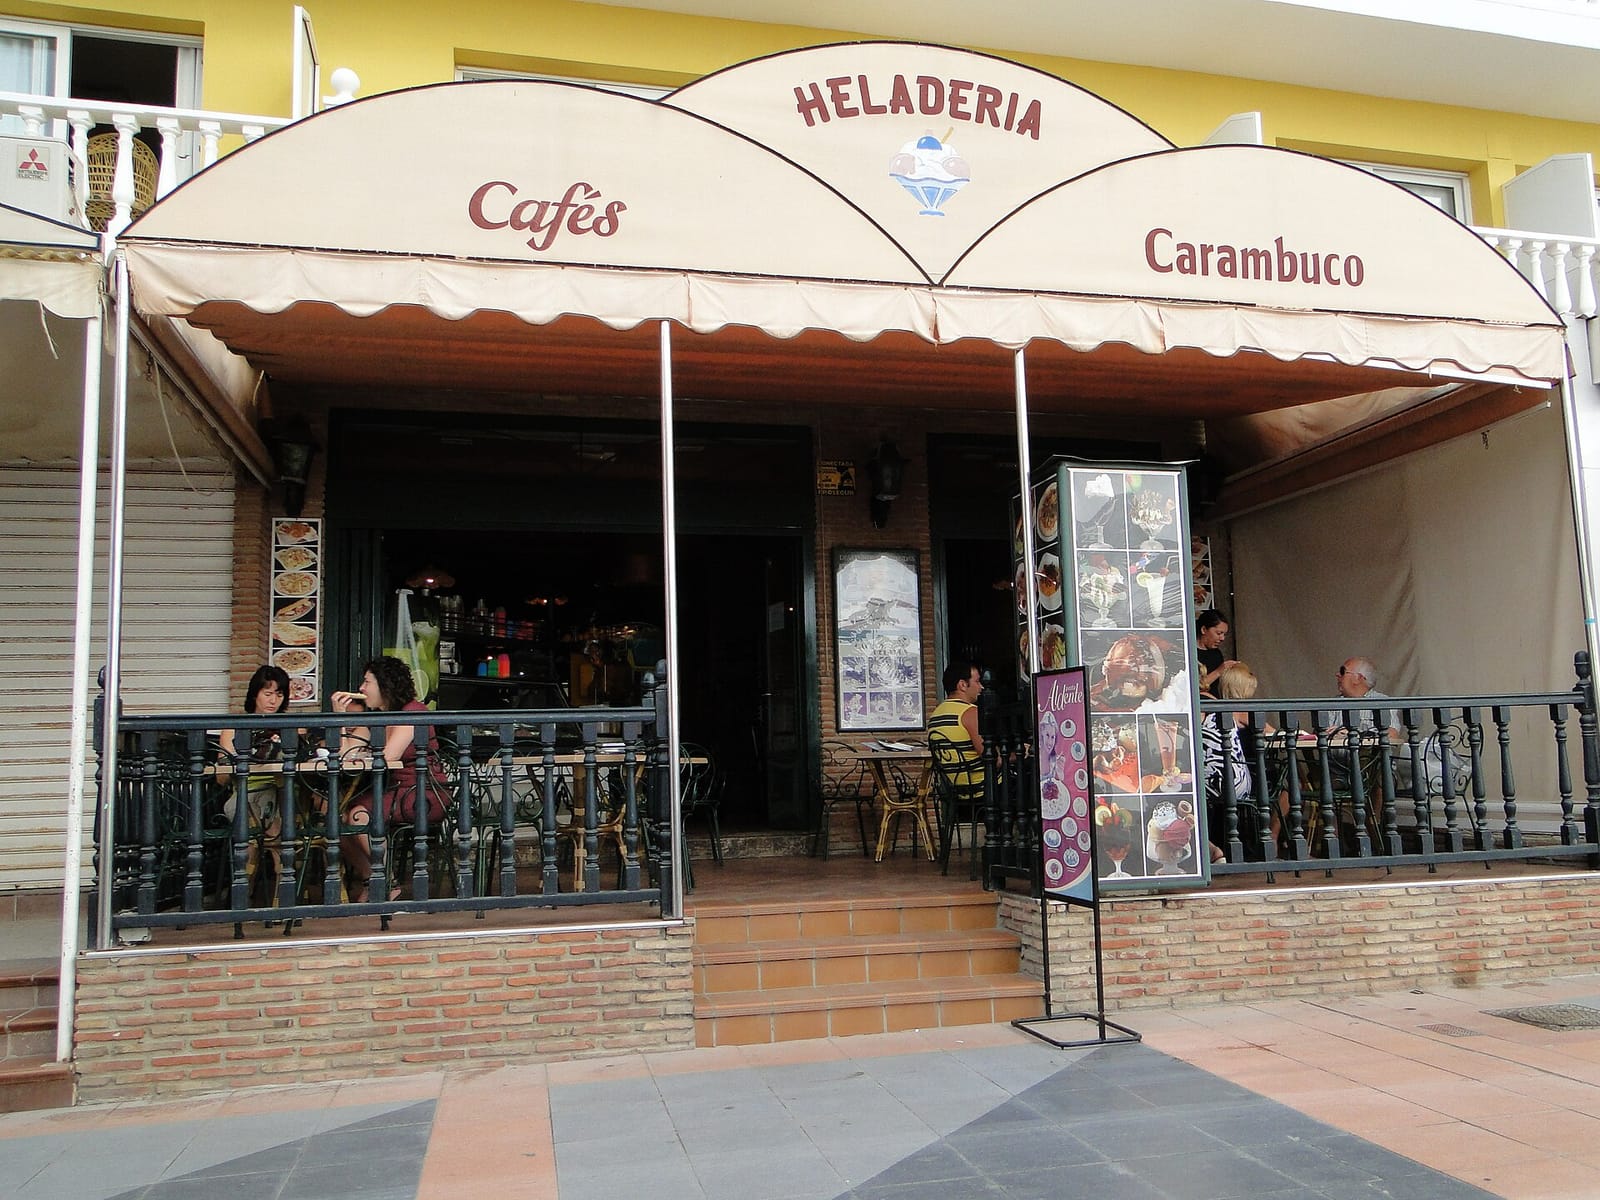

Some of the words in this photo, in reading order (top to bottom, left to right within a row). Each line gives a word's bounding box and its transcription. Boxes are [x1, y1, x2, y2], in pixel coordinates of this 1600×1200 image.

[794, 75, 1041, 140] HELADERIA
[468, 180, 628, 251] Cafés
[1145, 228, 1364, 287] Carambuco
